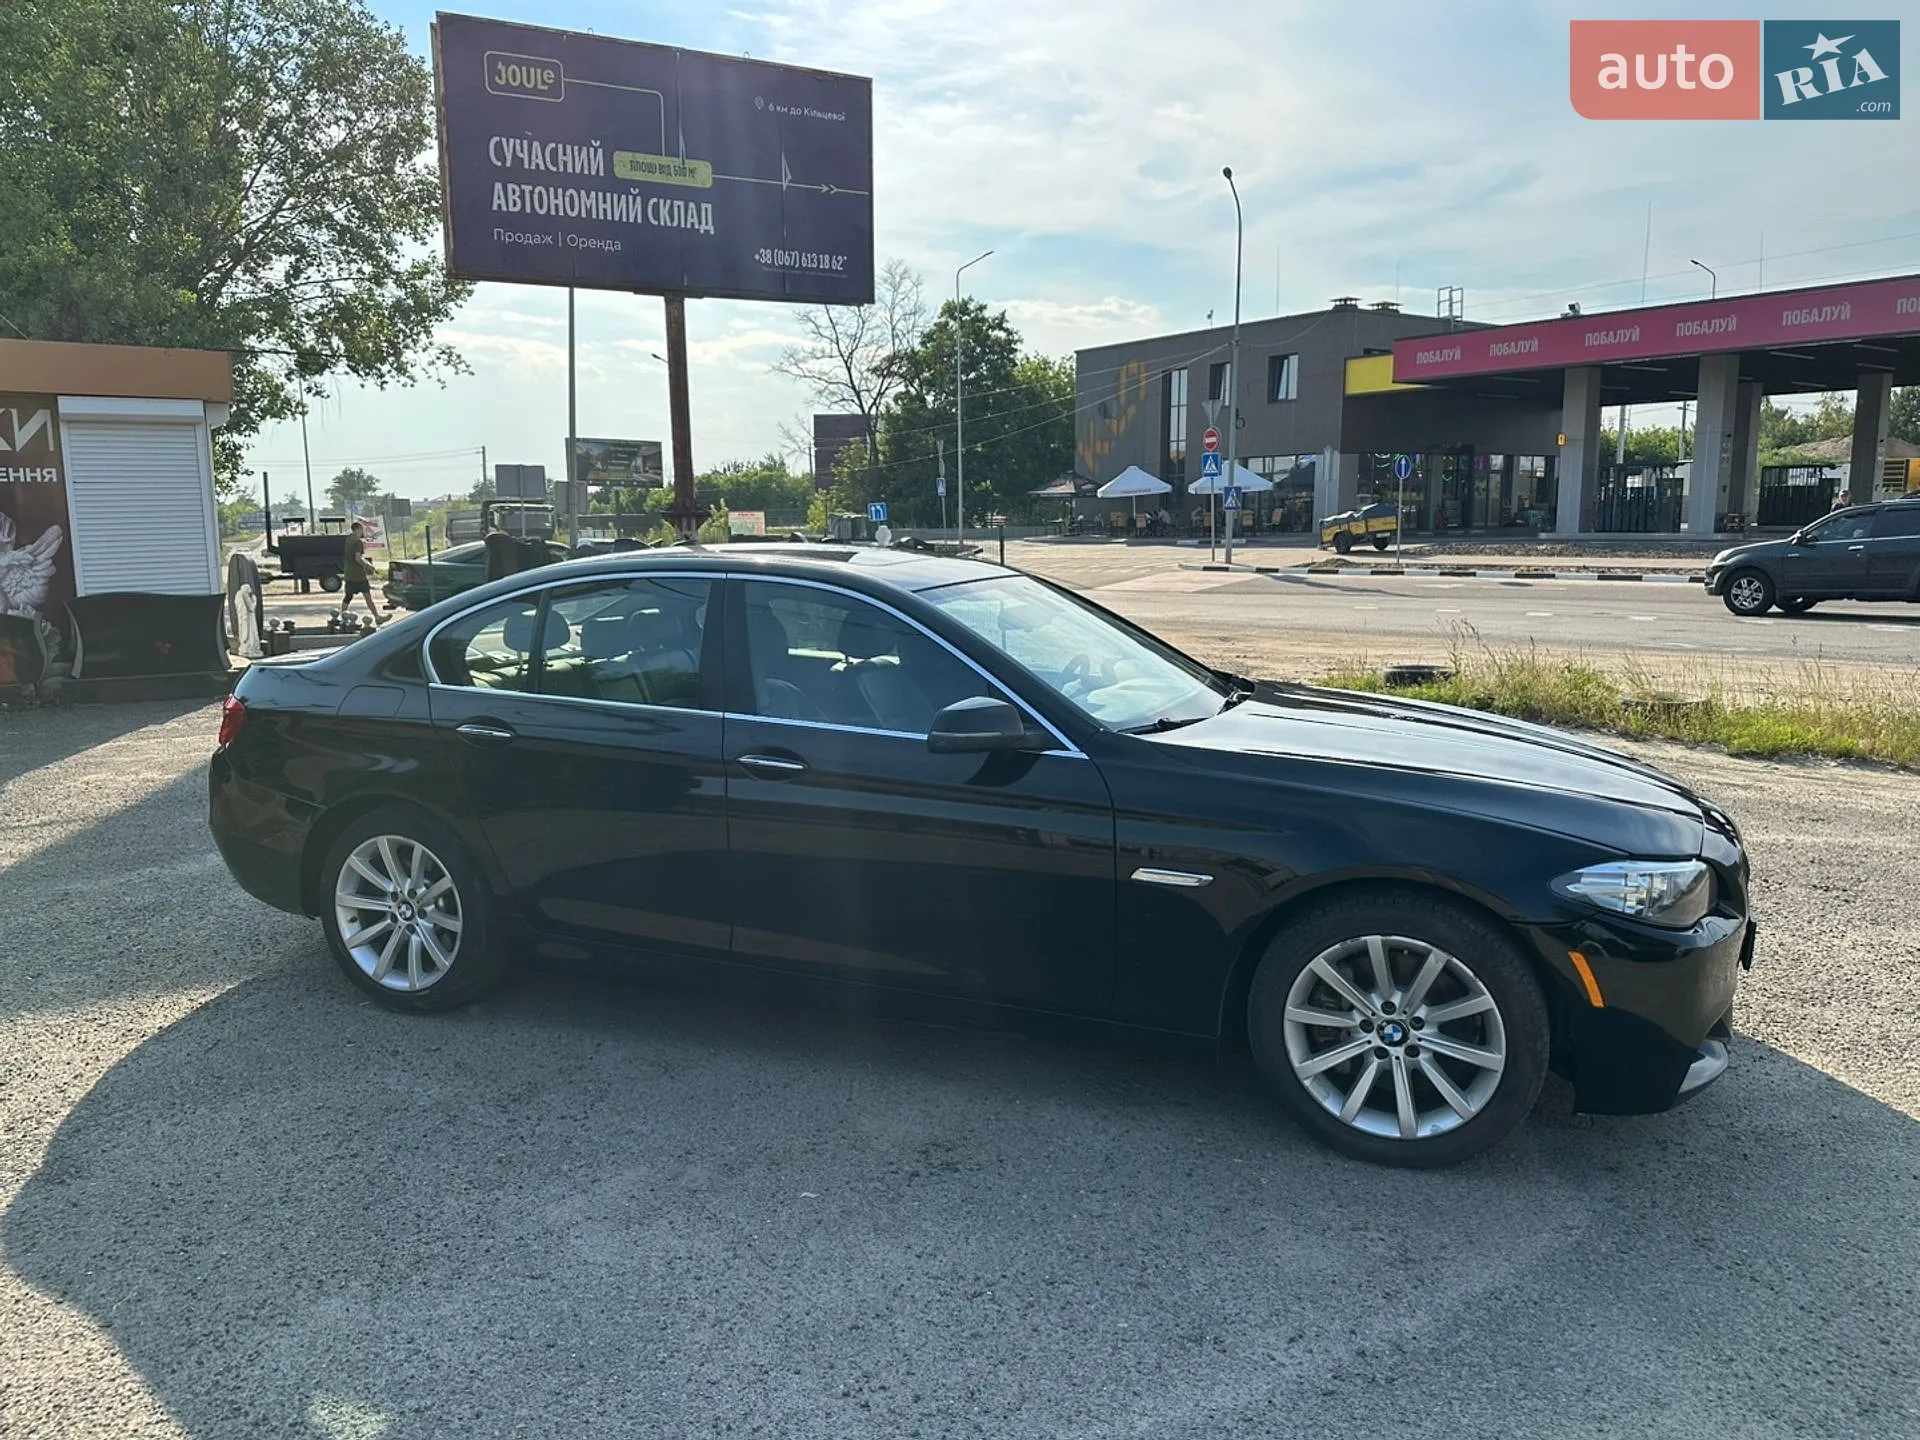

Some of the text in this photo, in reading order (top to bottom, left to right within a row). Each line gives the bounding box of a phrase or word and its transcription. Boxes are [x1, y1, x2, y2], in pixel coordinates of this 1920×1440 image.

[768, 102, 775, 112] 6
[776, 104, 788, 114] км
[789, 106, 802, 117] до
[489, 136, 604, 176] СУЧАСНИЙ
[491, 181, 715, 235] АВТОНОМНИЙ СКЛАД
[493, 227, 553, 246] Продаж
[566, 233, 622, 252] Оренда
[754, 248, 771, 264] +38
[774, 248, 800, 268] (067)
[801, 252, 817, 268] 613
[819, 254, 830, 269] 18
[1416, 297, 1920, 365] ПОБАЛУЙ ПОБАЛУЙ ПОБАЛУЙ ПОБАЛУЙ ПОБАЛУЙ ПО
